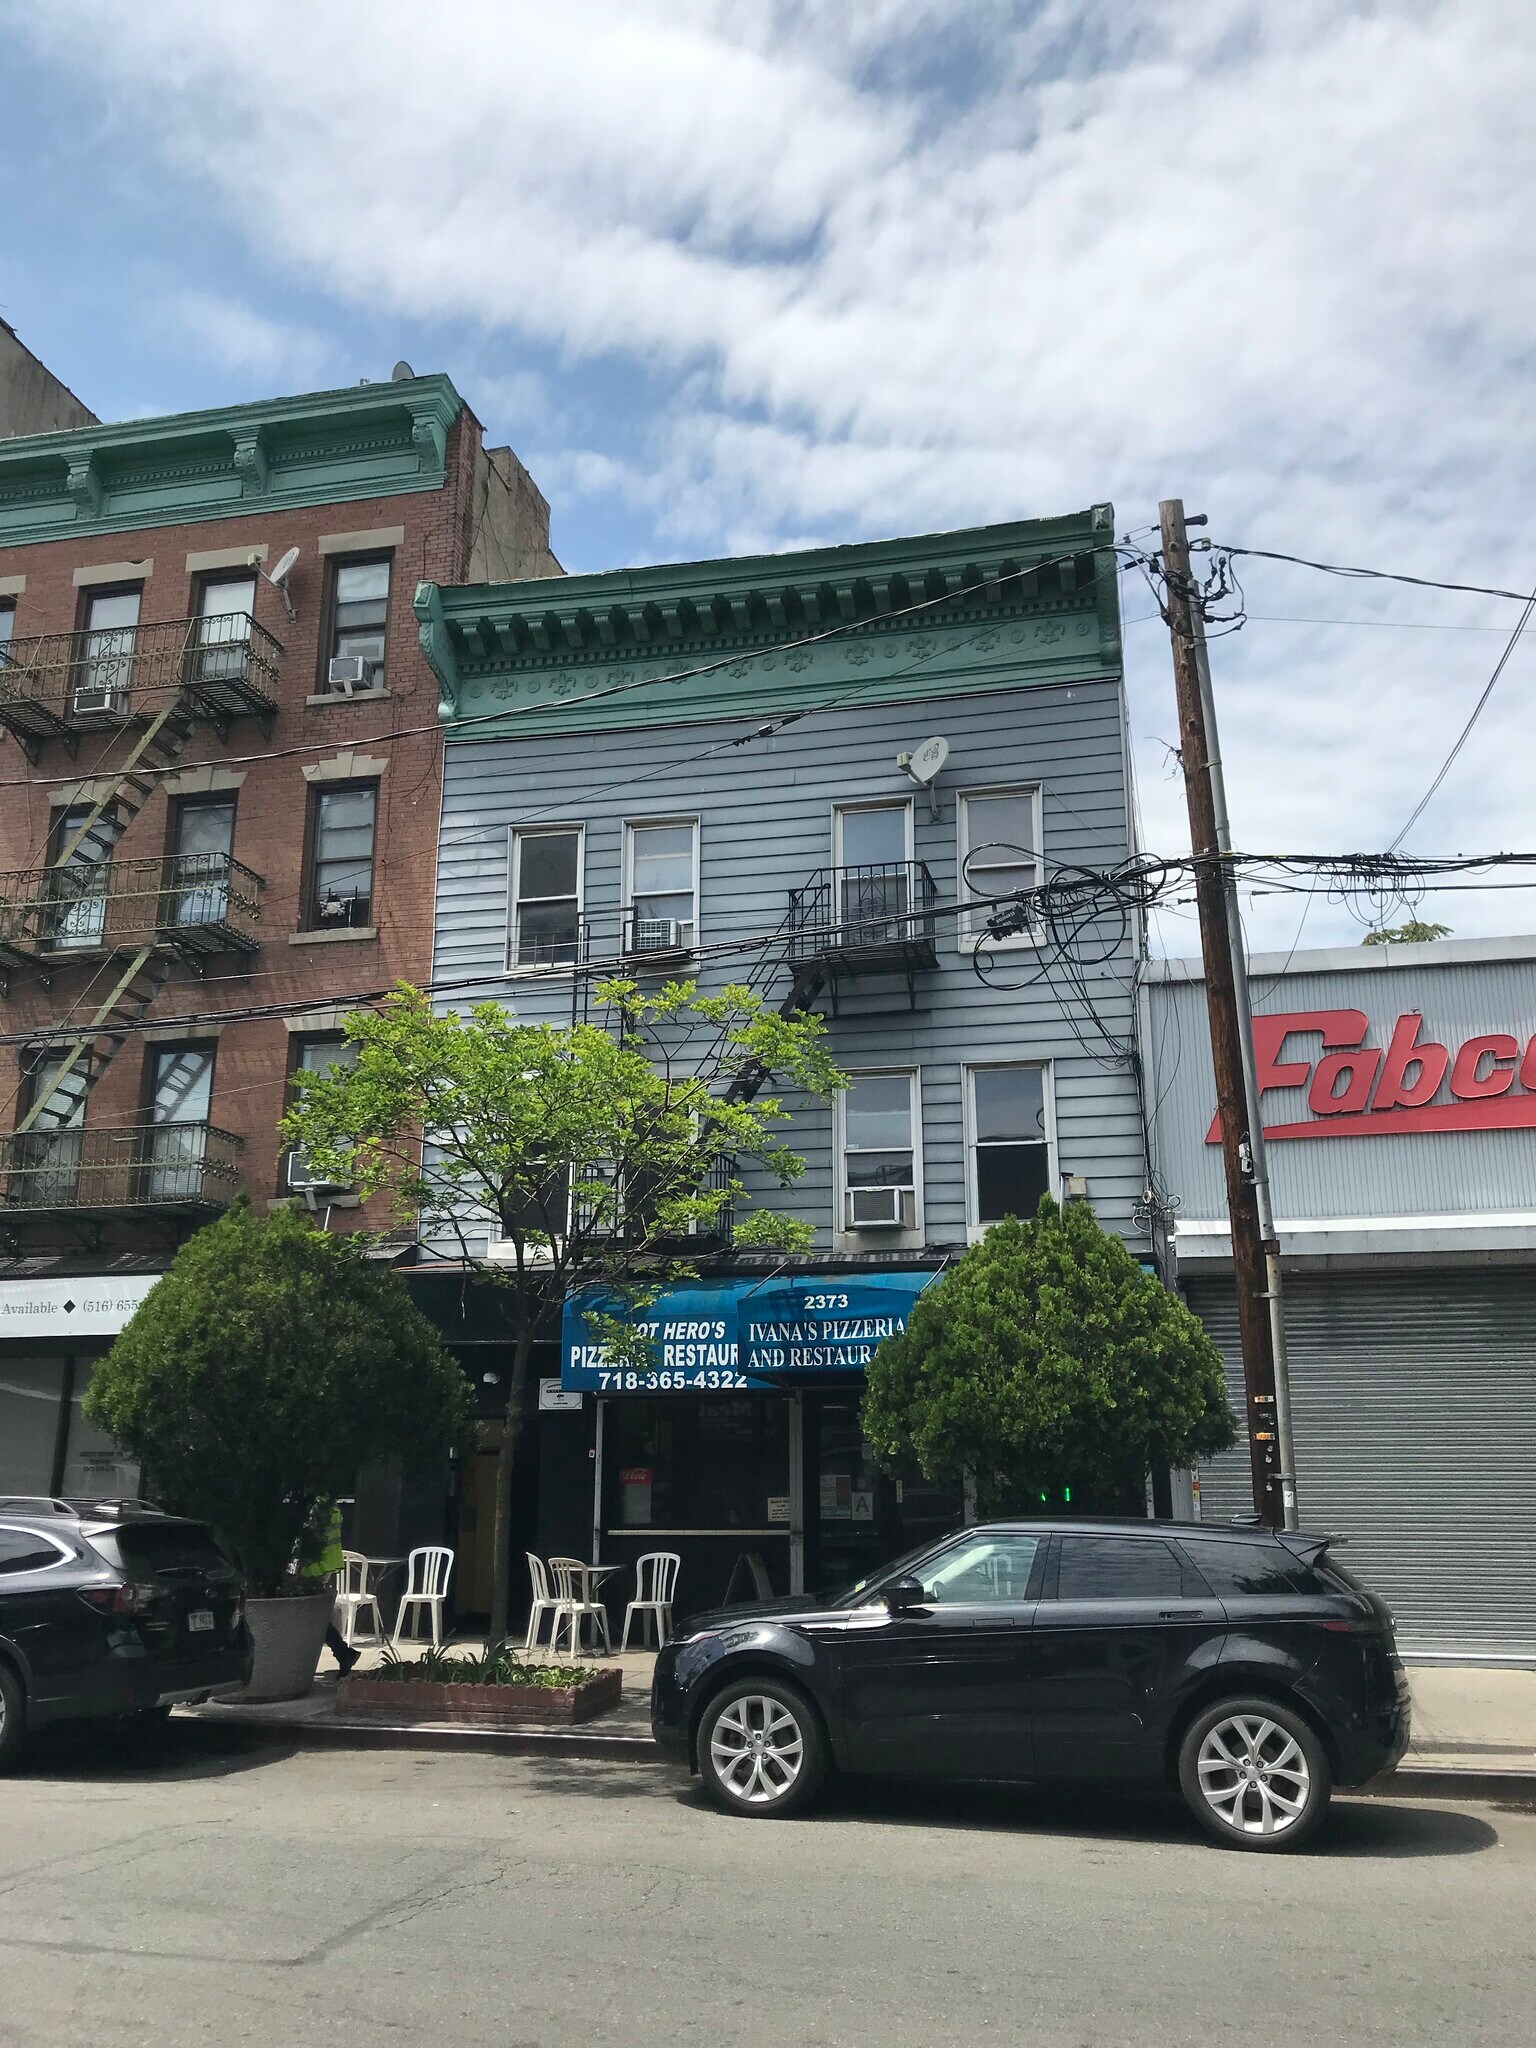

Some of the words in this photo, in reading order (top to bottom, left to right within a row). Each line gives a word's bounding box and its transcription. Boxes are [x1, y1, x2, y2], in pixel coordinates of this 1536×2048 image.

[1251, 1008, 1536, 1114] Fabc
[2, 1302, 58, 1314] Available
[83, 1299, 113, 1313] (516)
[117, 1299, 138, 1312] 655
[804, 1294, 849, 1309] 2373
[626, 1323, 660, 1341] OT
[662, 1321, 726, 1340] HERO'S
[749, 1320, 818, 1343] IVANA'S
[822, 1317, 905, 1340] PIZZERIA
[570, 1346, 648, 1368] PIZZ
[664, 1344, 739, 1367] RESTAUR
[748, 1347, 785, 1368] AND
[599, 1370, 748, 1390] 718-365-4322
[855, 1495, 869, 1512] A
